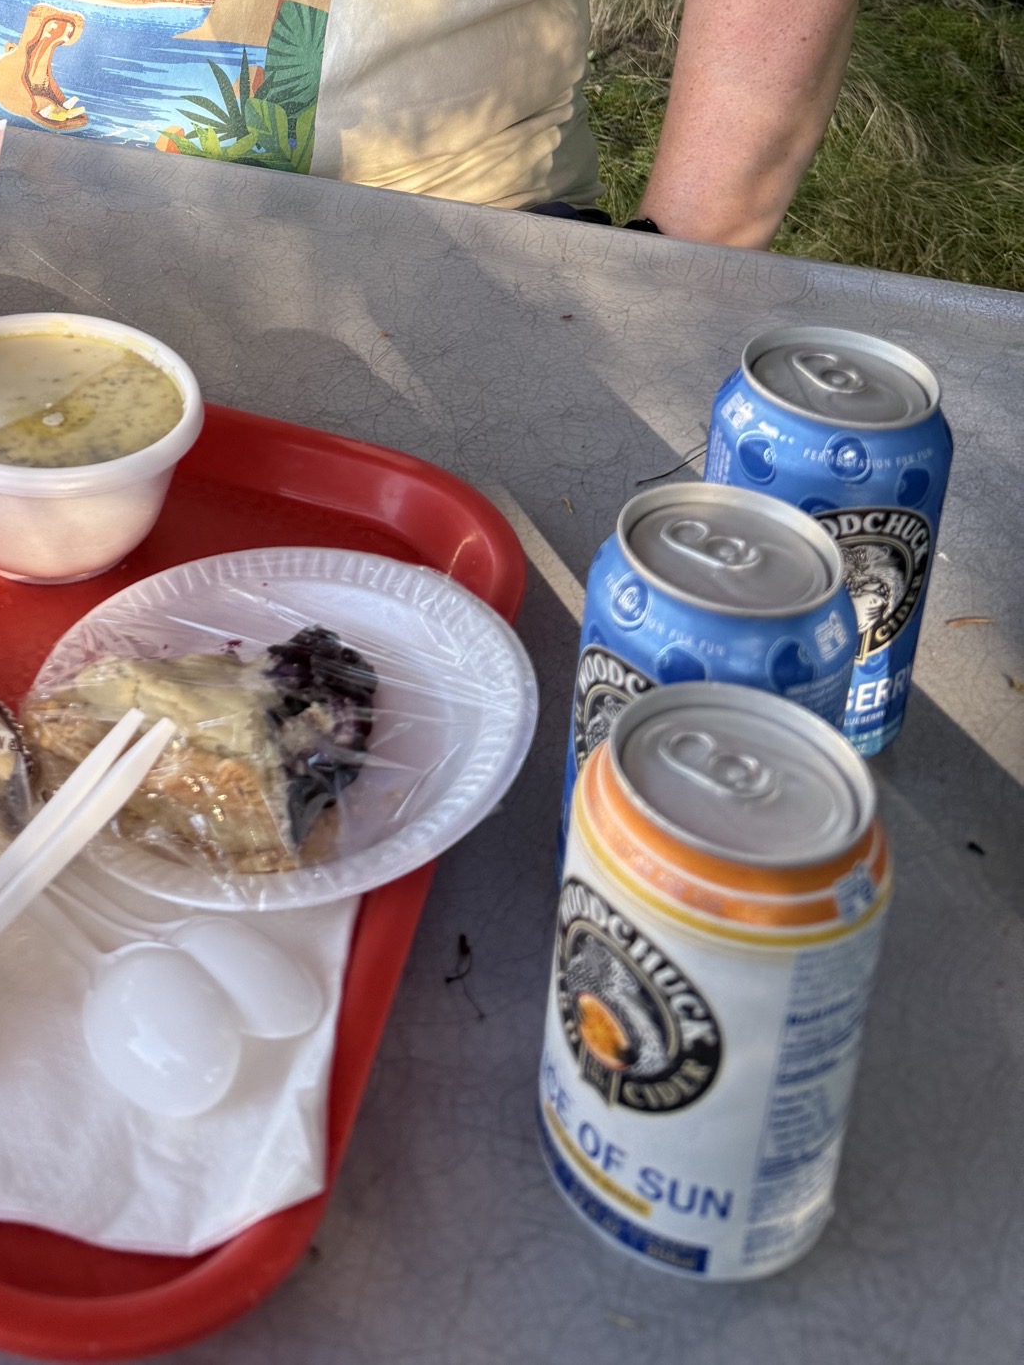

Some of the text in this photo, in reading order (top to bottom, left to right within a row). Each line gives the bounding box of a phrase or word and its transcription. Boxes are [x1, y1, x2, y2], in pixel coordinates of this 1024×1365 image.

[578, 653, 647, 696] WOODC
[578, 1120, 626, 1172] OF
[636, 1166, 734, 1221] SUN
